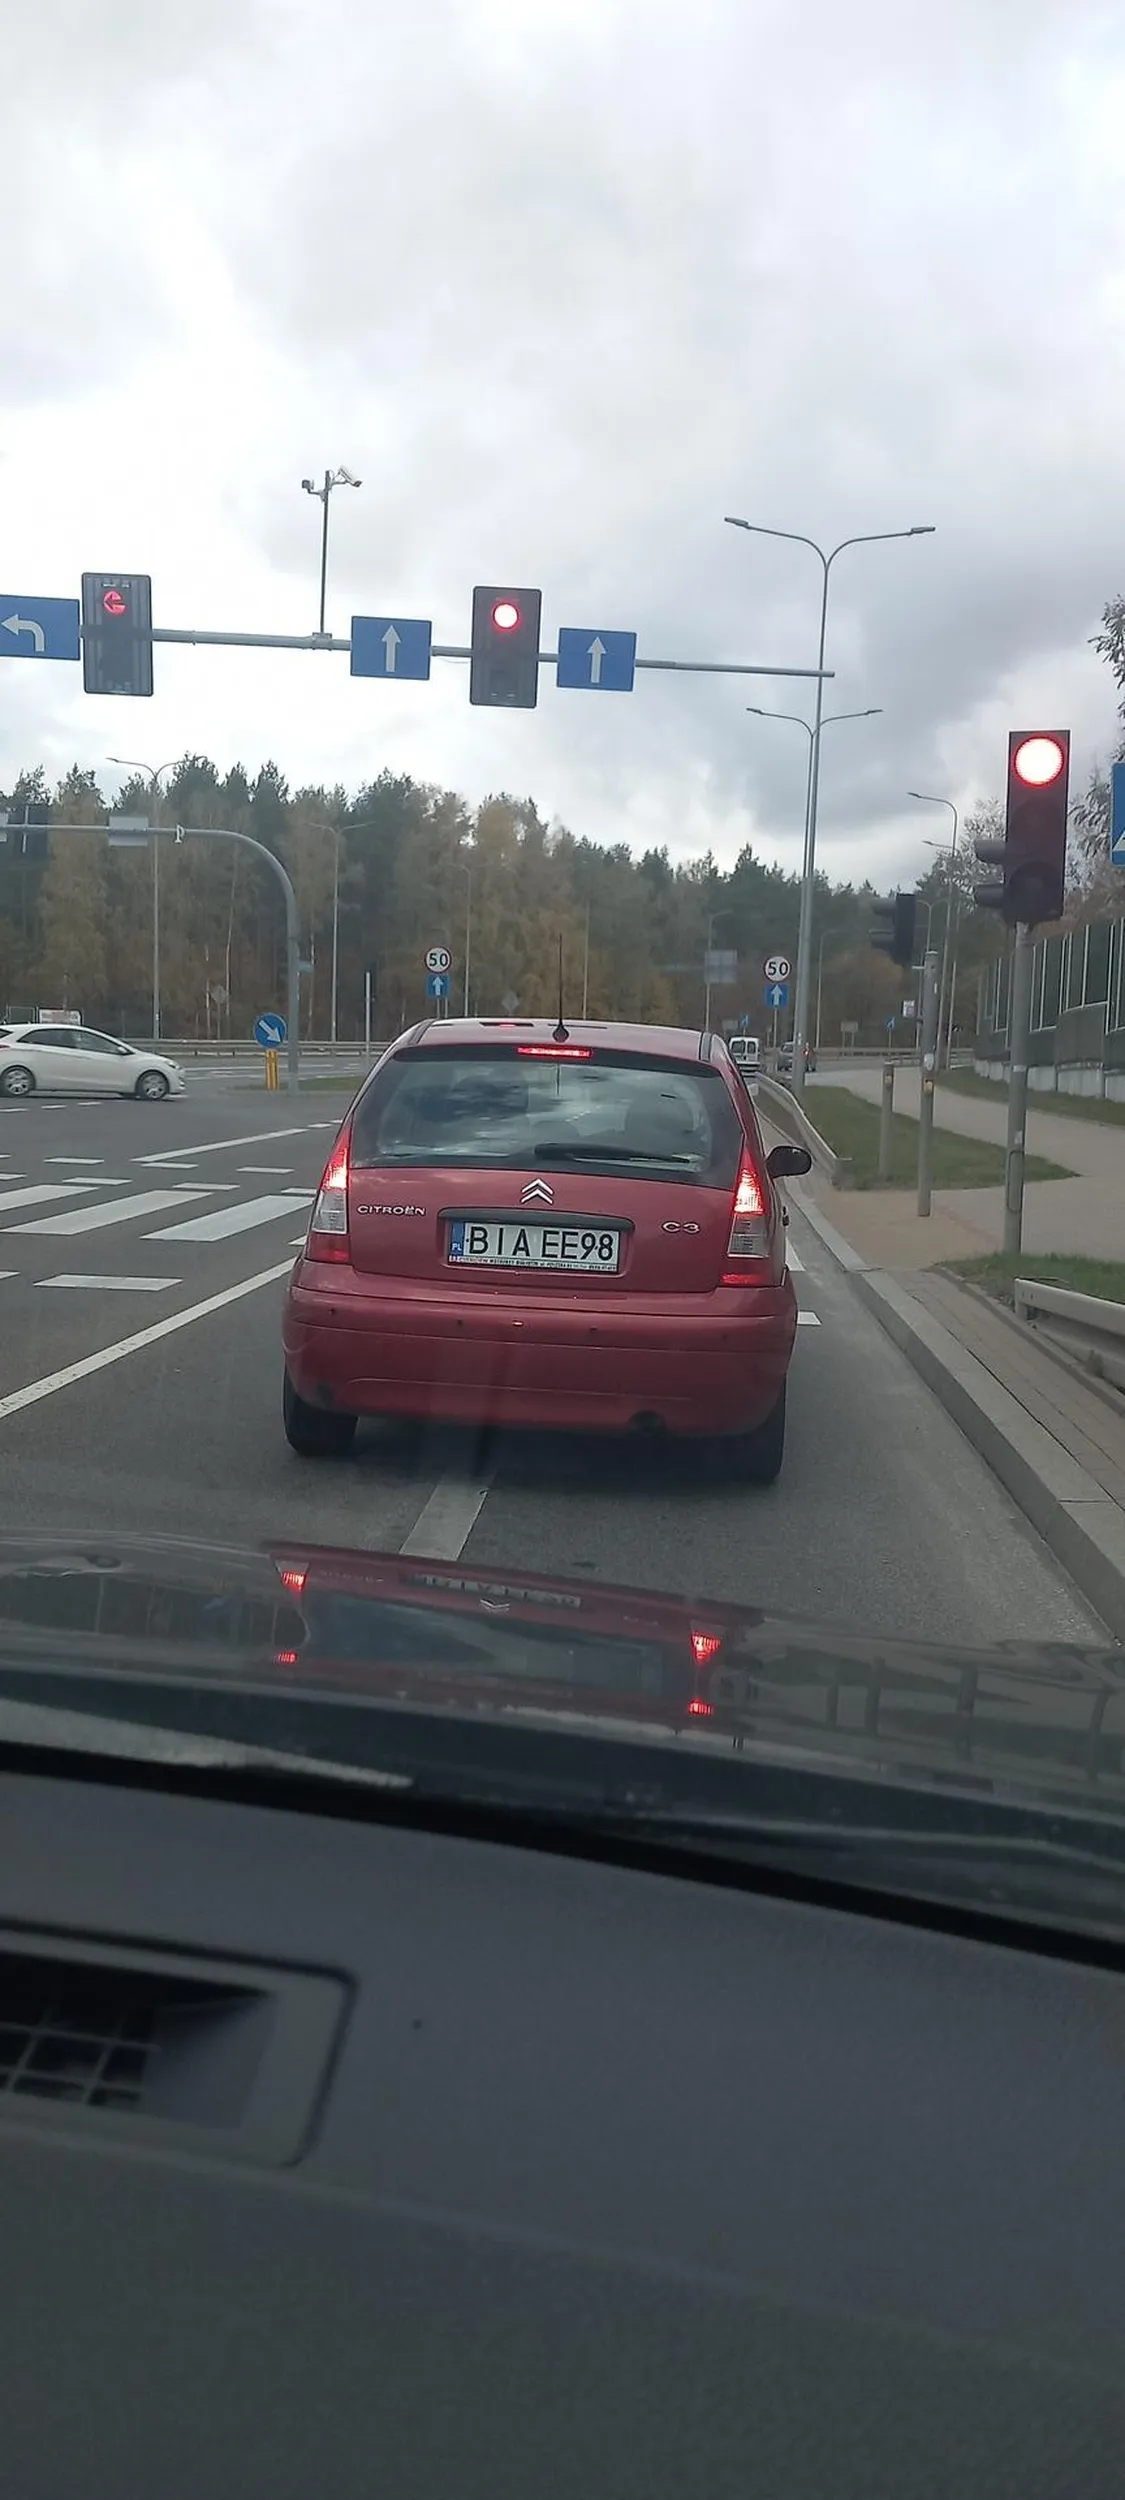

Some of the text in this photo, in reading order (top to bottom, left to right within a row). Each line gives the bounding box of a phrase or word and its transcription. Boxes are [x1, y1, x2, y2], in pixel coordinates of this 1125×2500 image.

[429, 952, 449, 967] 50
[768, 961, 789, 976] 50
[662, 1222, 700, 1234] C3
[452, 1243, 462, 1251] PL
[541, 1230, 614, 1261] EE98
